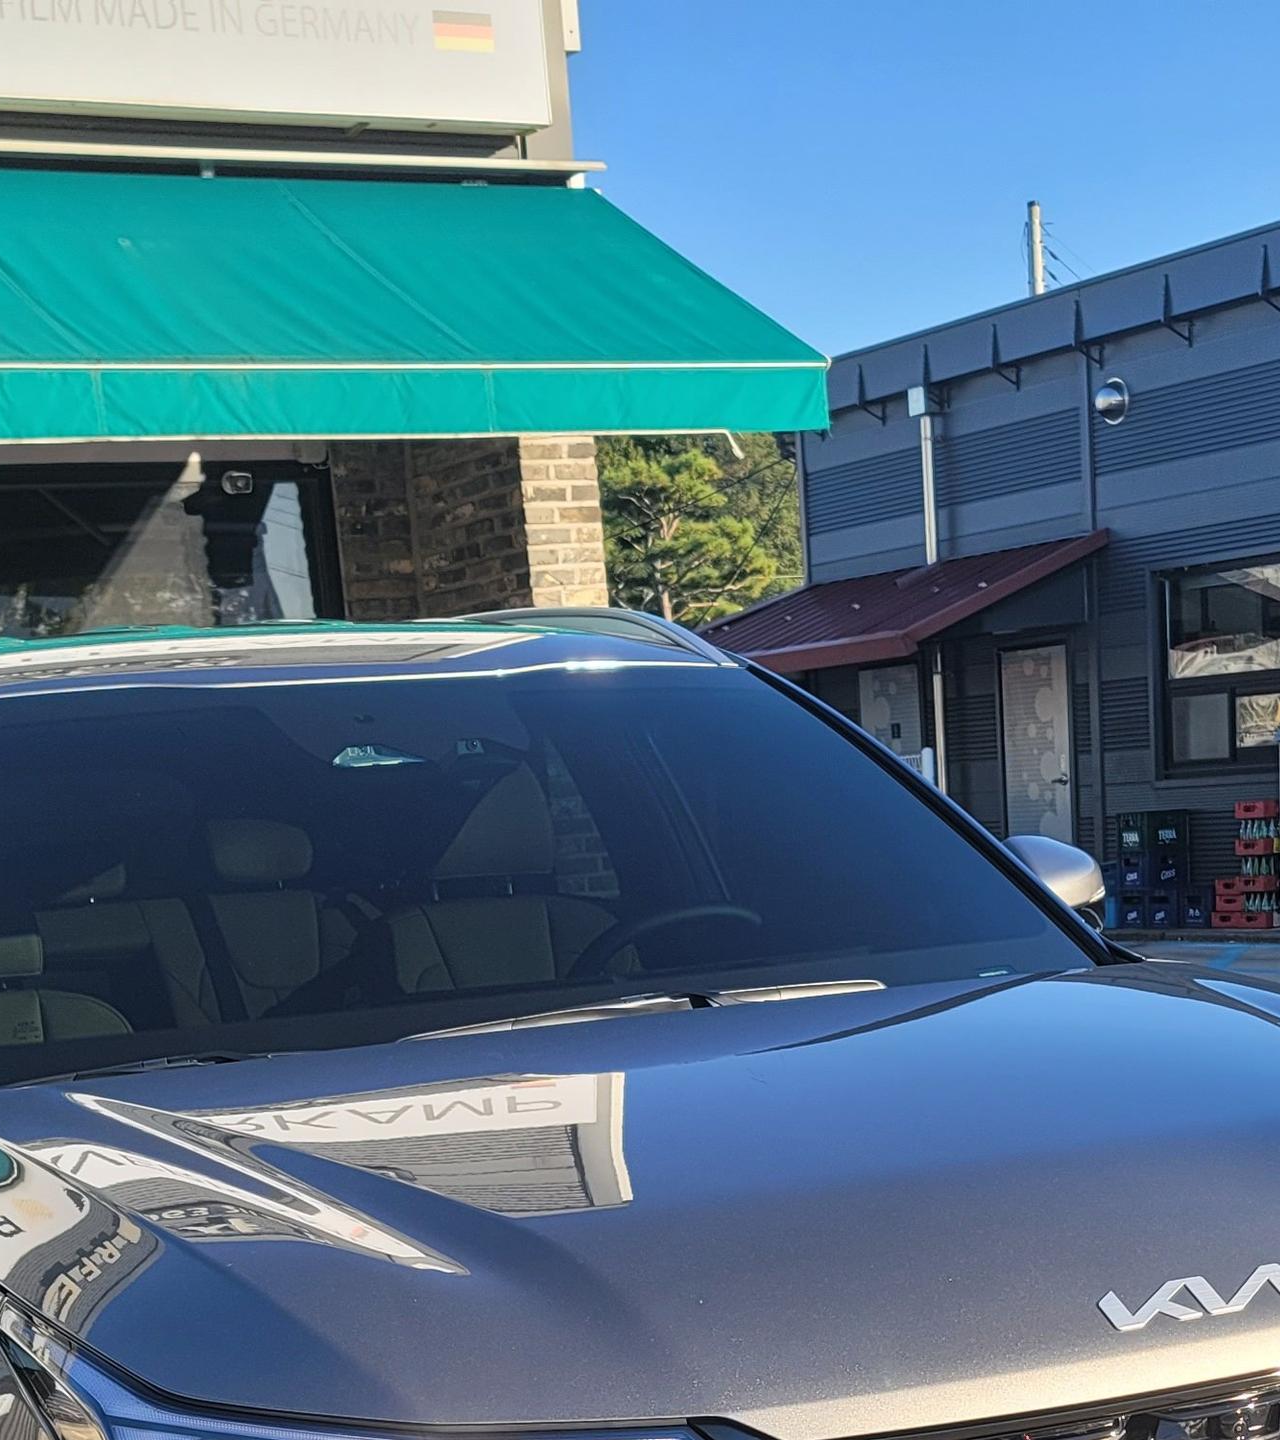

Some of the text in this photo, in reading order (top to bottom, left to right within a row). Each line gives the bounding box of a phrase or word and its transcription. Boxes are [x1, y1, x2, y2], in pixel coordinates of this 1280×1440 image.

[94, 0, 200, 32] MADE
[210, 1, 244, 35] IN
[254, 4, 421, 45] GERMANY
